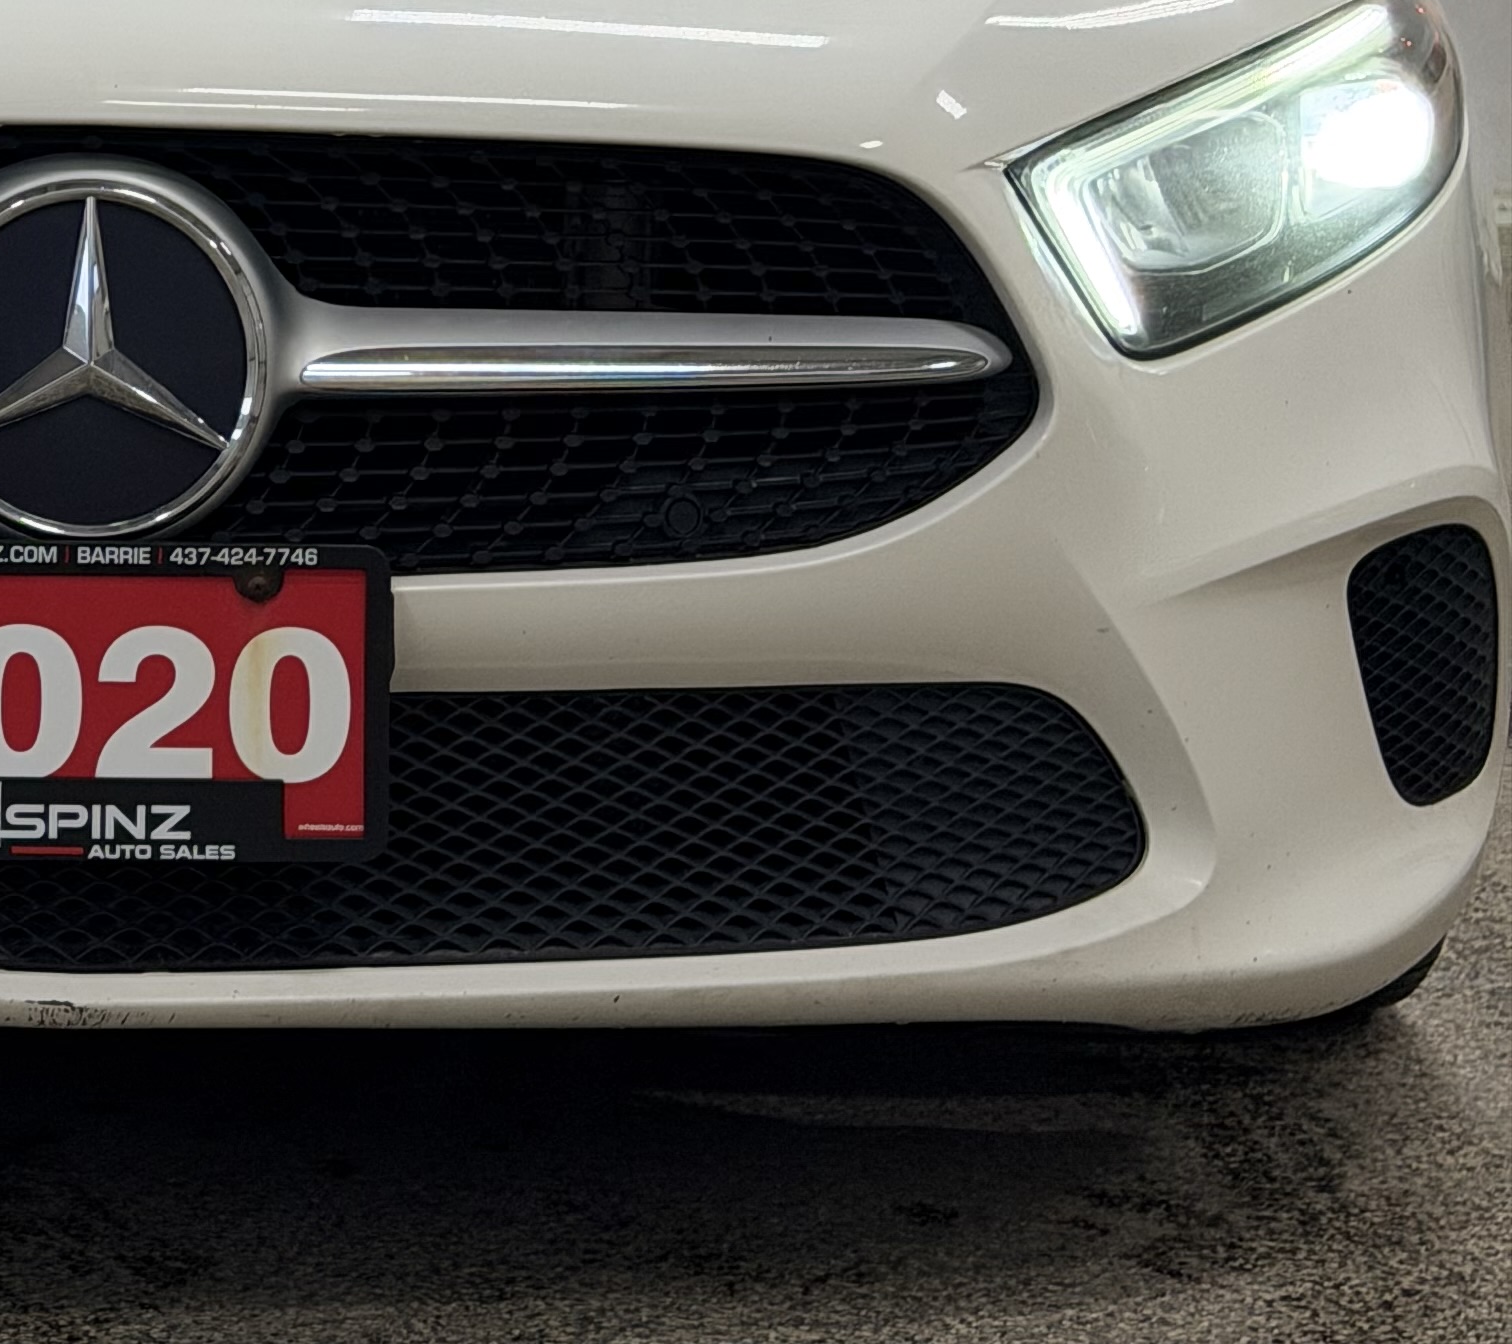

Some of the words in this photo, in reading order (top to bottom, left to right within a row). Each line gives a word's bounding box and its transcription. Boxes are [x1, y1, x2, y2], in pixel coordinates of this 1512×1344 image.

[77, 546, 151, 565] BARRIE
[170, 547, 318, 566] 437-424-7746
[87, 844, 152, 860] AUTO
[160, 845, 236, 860] SALES
